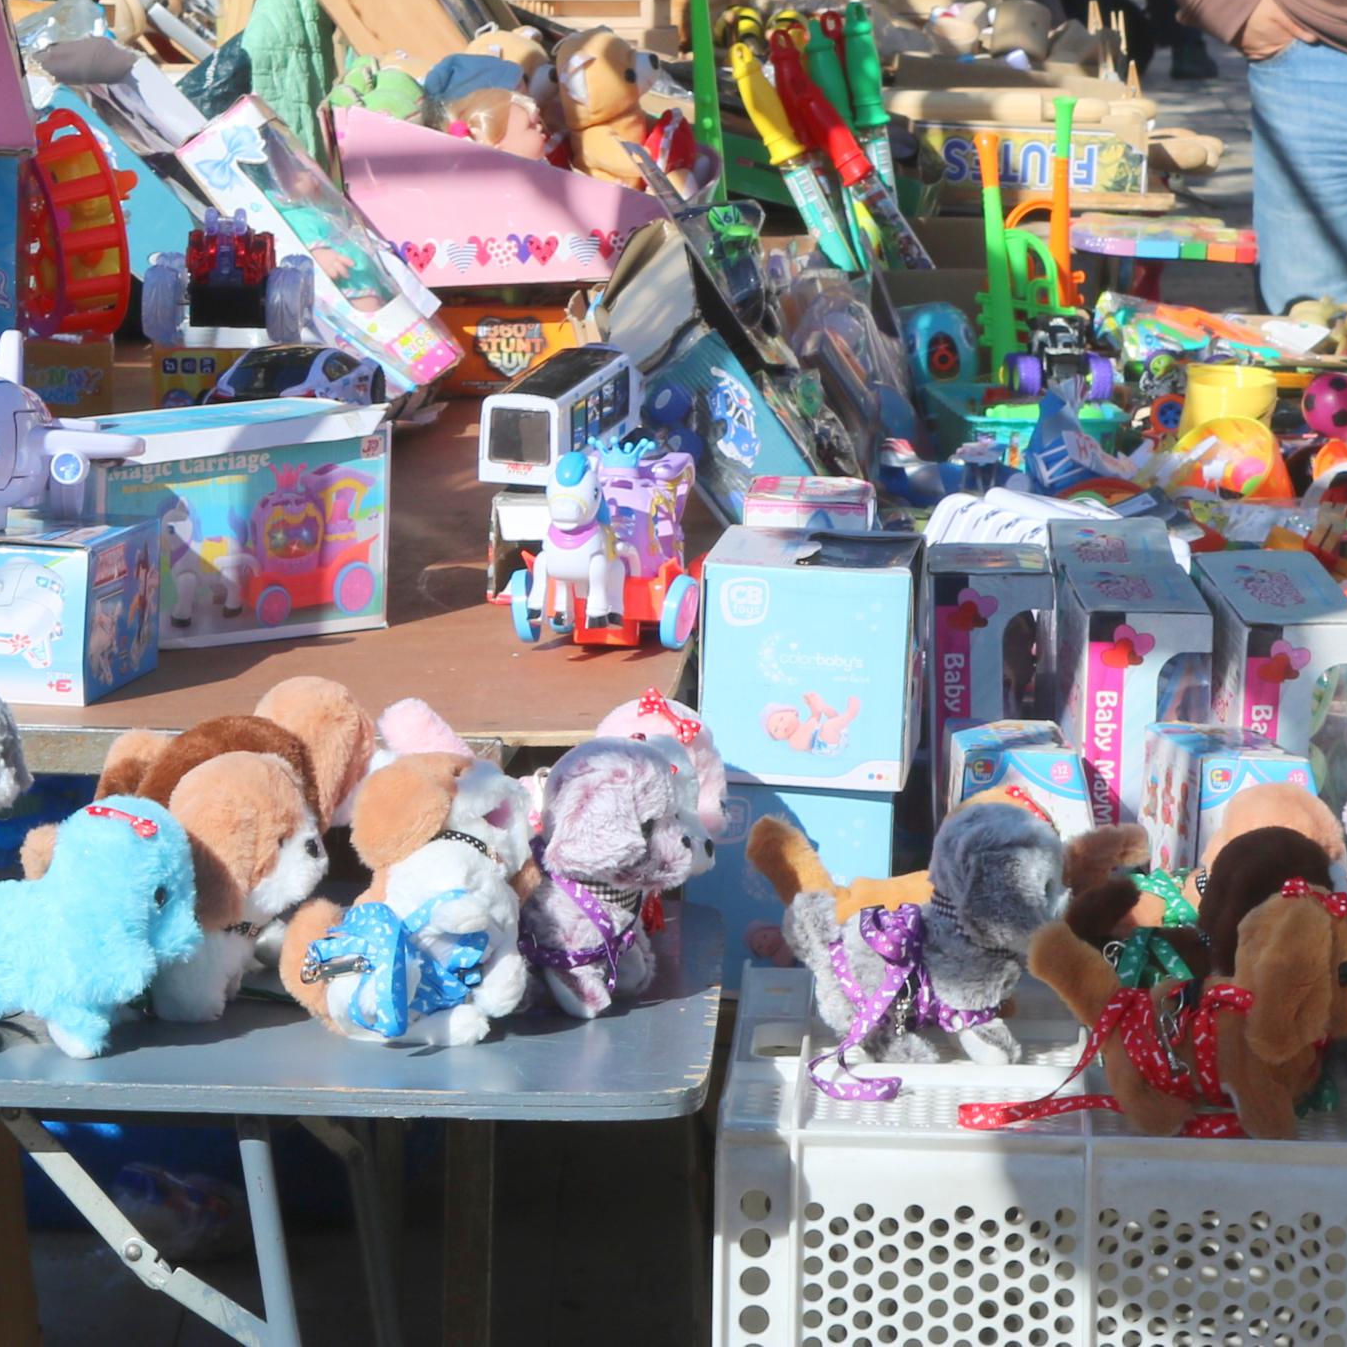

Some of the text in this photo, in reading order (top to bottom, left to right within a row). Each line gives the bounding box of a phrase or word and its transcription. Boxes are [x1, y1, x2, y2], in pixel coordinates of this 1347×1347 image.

[943, 139, 1097, 186] FUTS
[479, 338, 542, 352] STUNT
[488, 353, 533, 369] SUV
[179, 452, 271, 474] Carriage
[731, 585, 762, 604] CB
[944, 653, 965, 712] Baby
[1094, 691, 1118, 751] Baby
[1251, 705, 1273, 735] Ba
